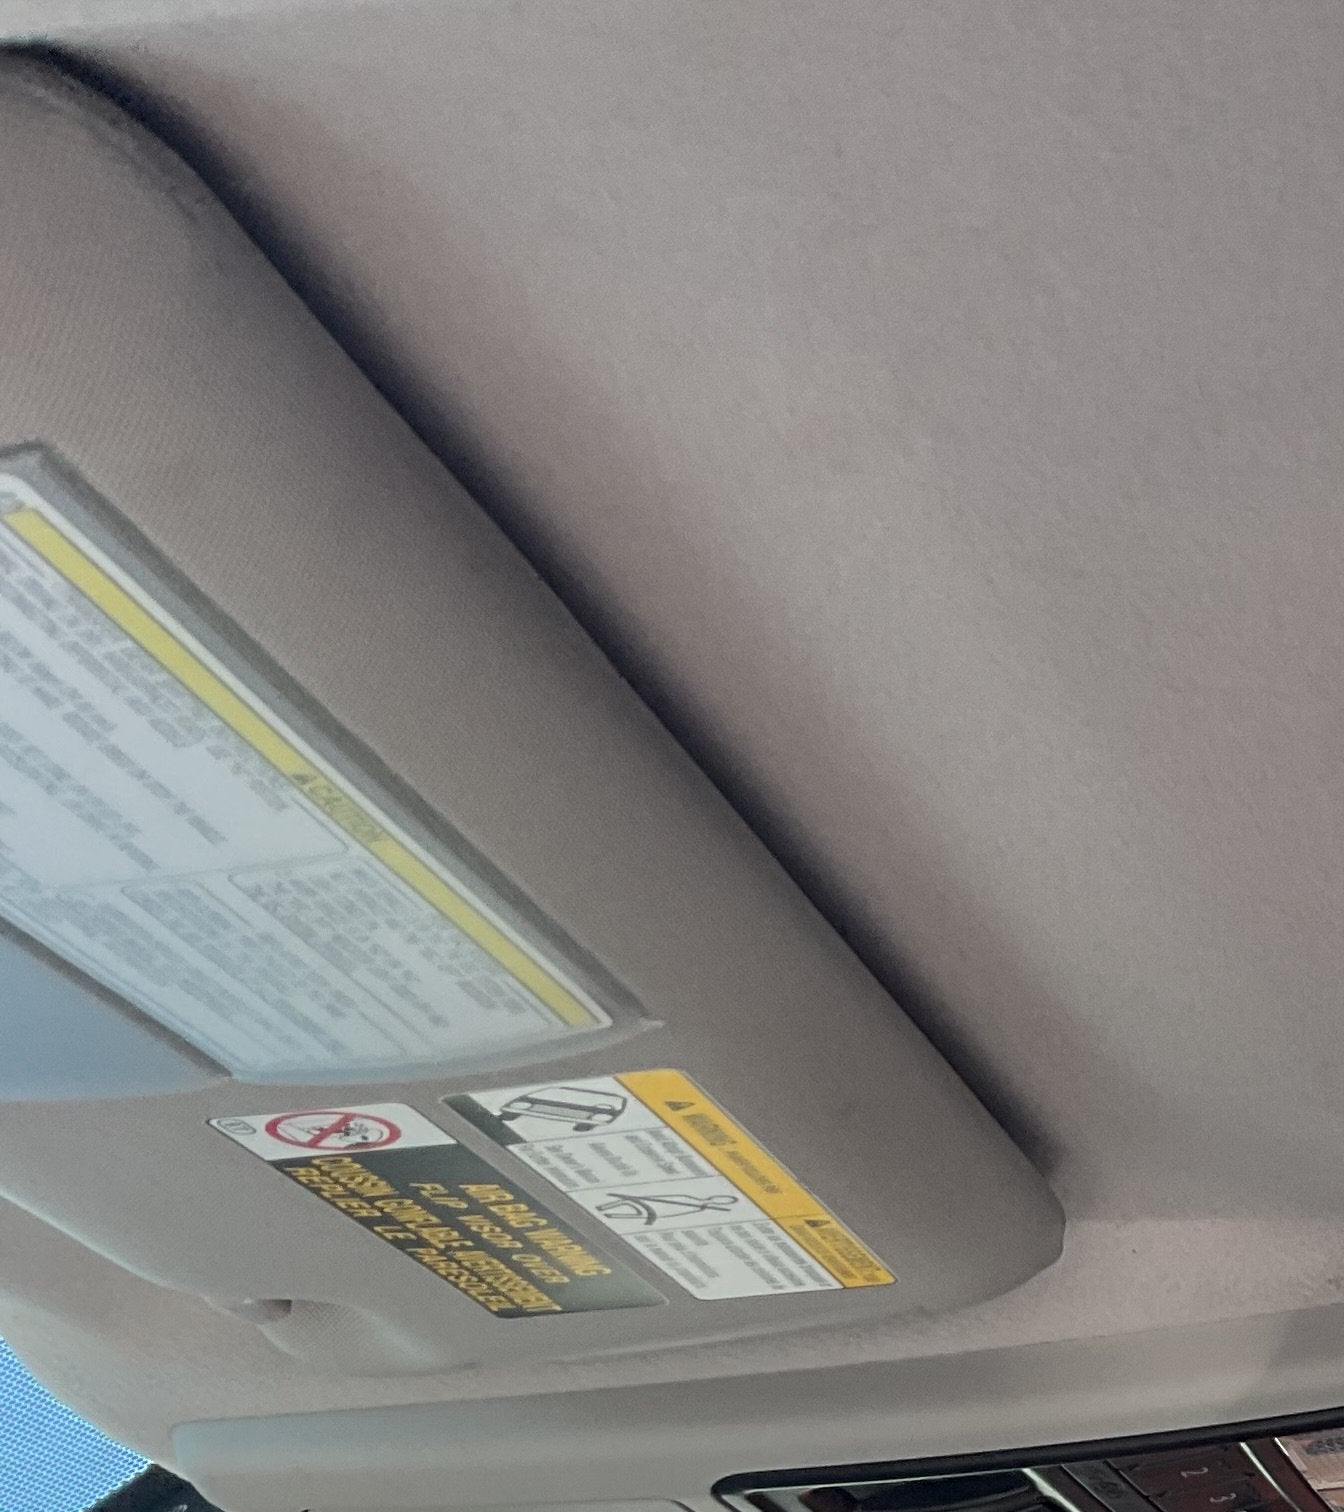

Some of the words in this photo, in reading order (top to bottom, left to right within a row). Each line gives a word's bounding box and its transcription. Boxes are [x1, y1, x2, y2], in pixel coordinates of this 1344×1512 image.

[284, 1167, 382, 1217] REPLIER
[373, 1225, 417, 1240] LE
[409, 1183, 469, 1209] FLIP
[456, 1215, 523, 1248] VISOR
[511, 1254, 570, 1283] OVER
[459, 1184, 514, 1203] AIR
[487, 1203, 548, 1228] BAG
[523, 1228, 612, 1276] WARNING
